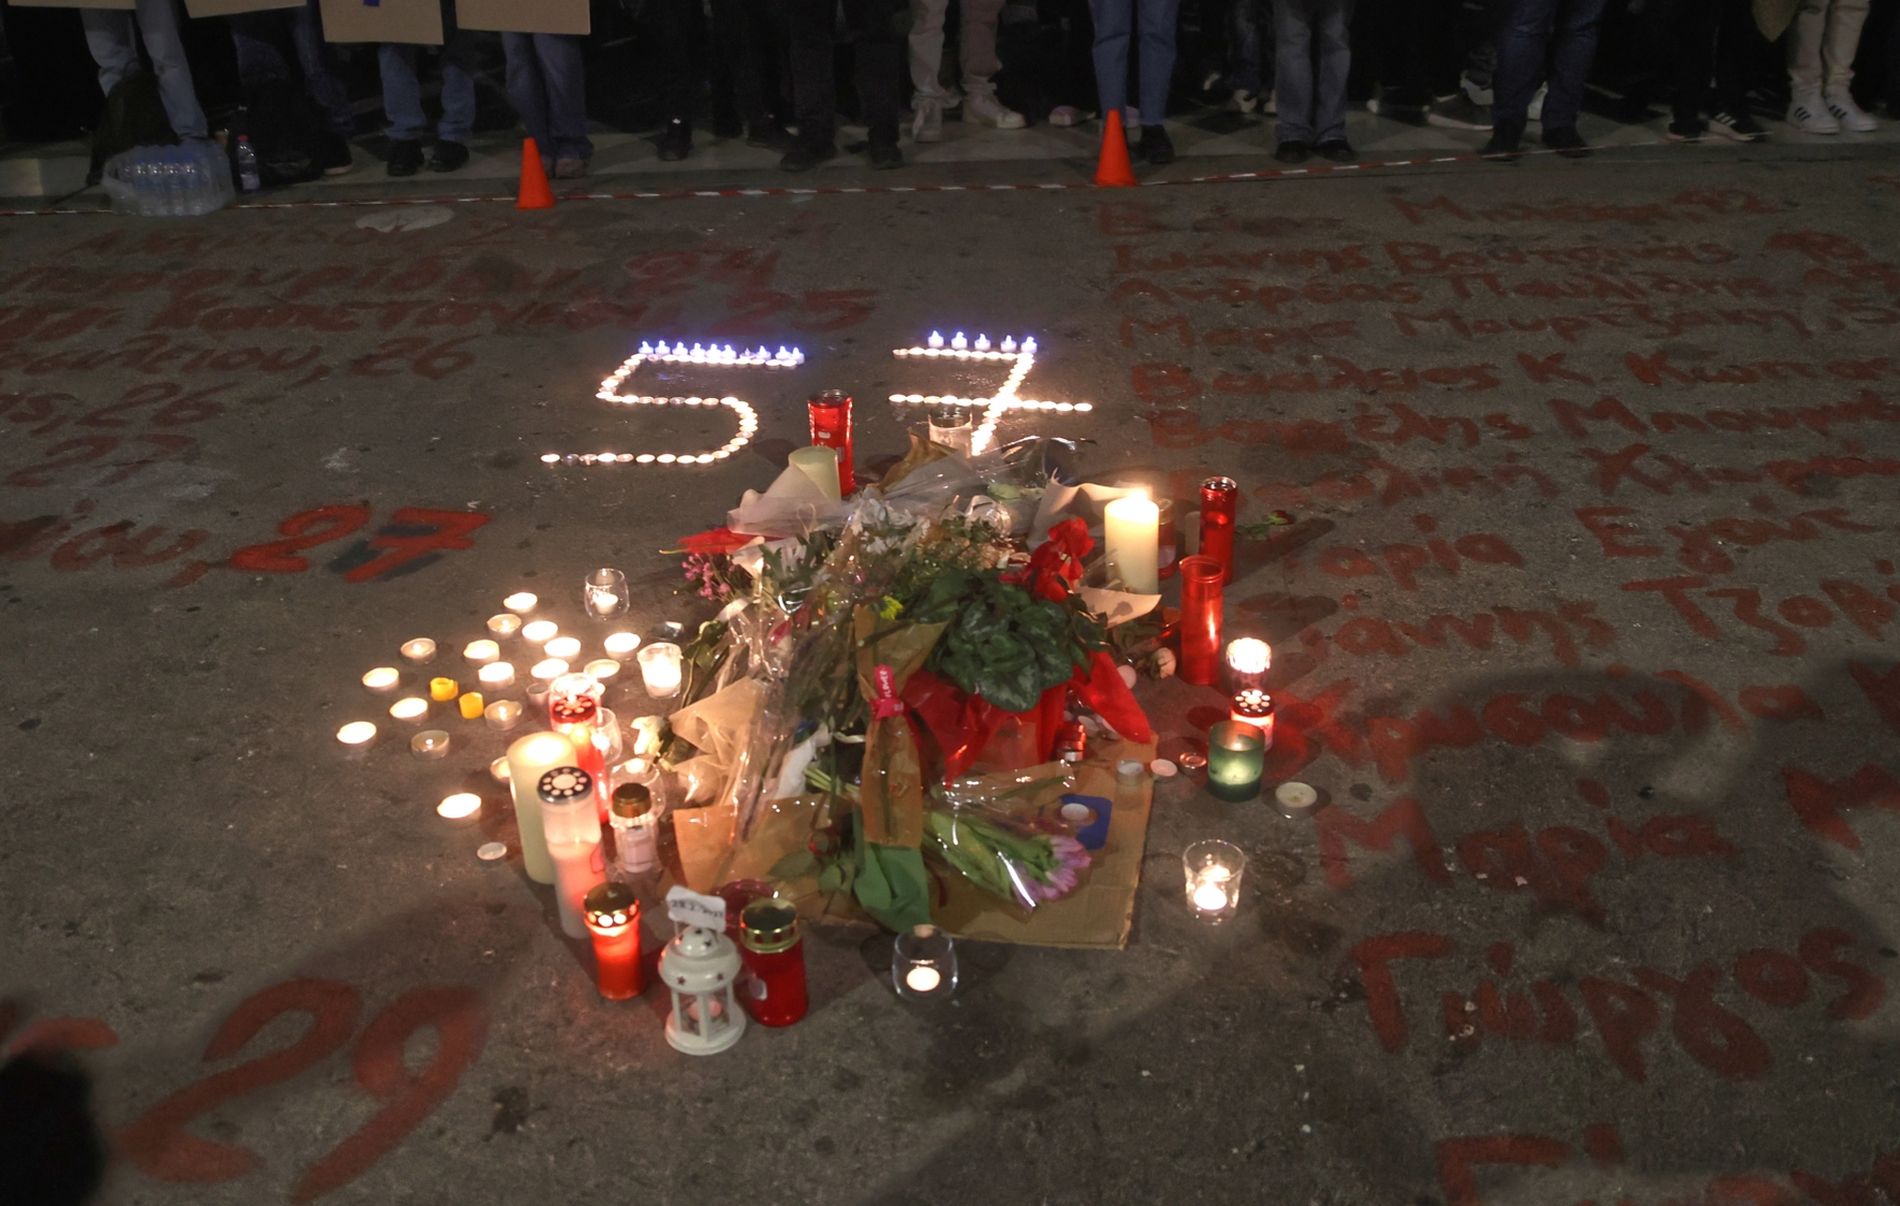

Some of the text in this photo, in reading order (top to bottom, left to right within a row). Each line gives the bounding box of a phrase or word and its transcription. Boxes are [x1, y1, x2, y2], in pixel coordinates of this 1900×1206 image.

[75, 382, 239, 427] 26
[350, 334, 484, 380] 26
[228, 504, 491, 583] 27
[1313, 776, 1740, 925] Μαρία
[1348, 927, 1887, 1083] Γιώργος
[107, 975, 491, 1206] 29
